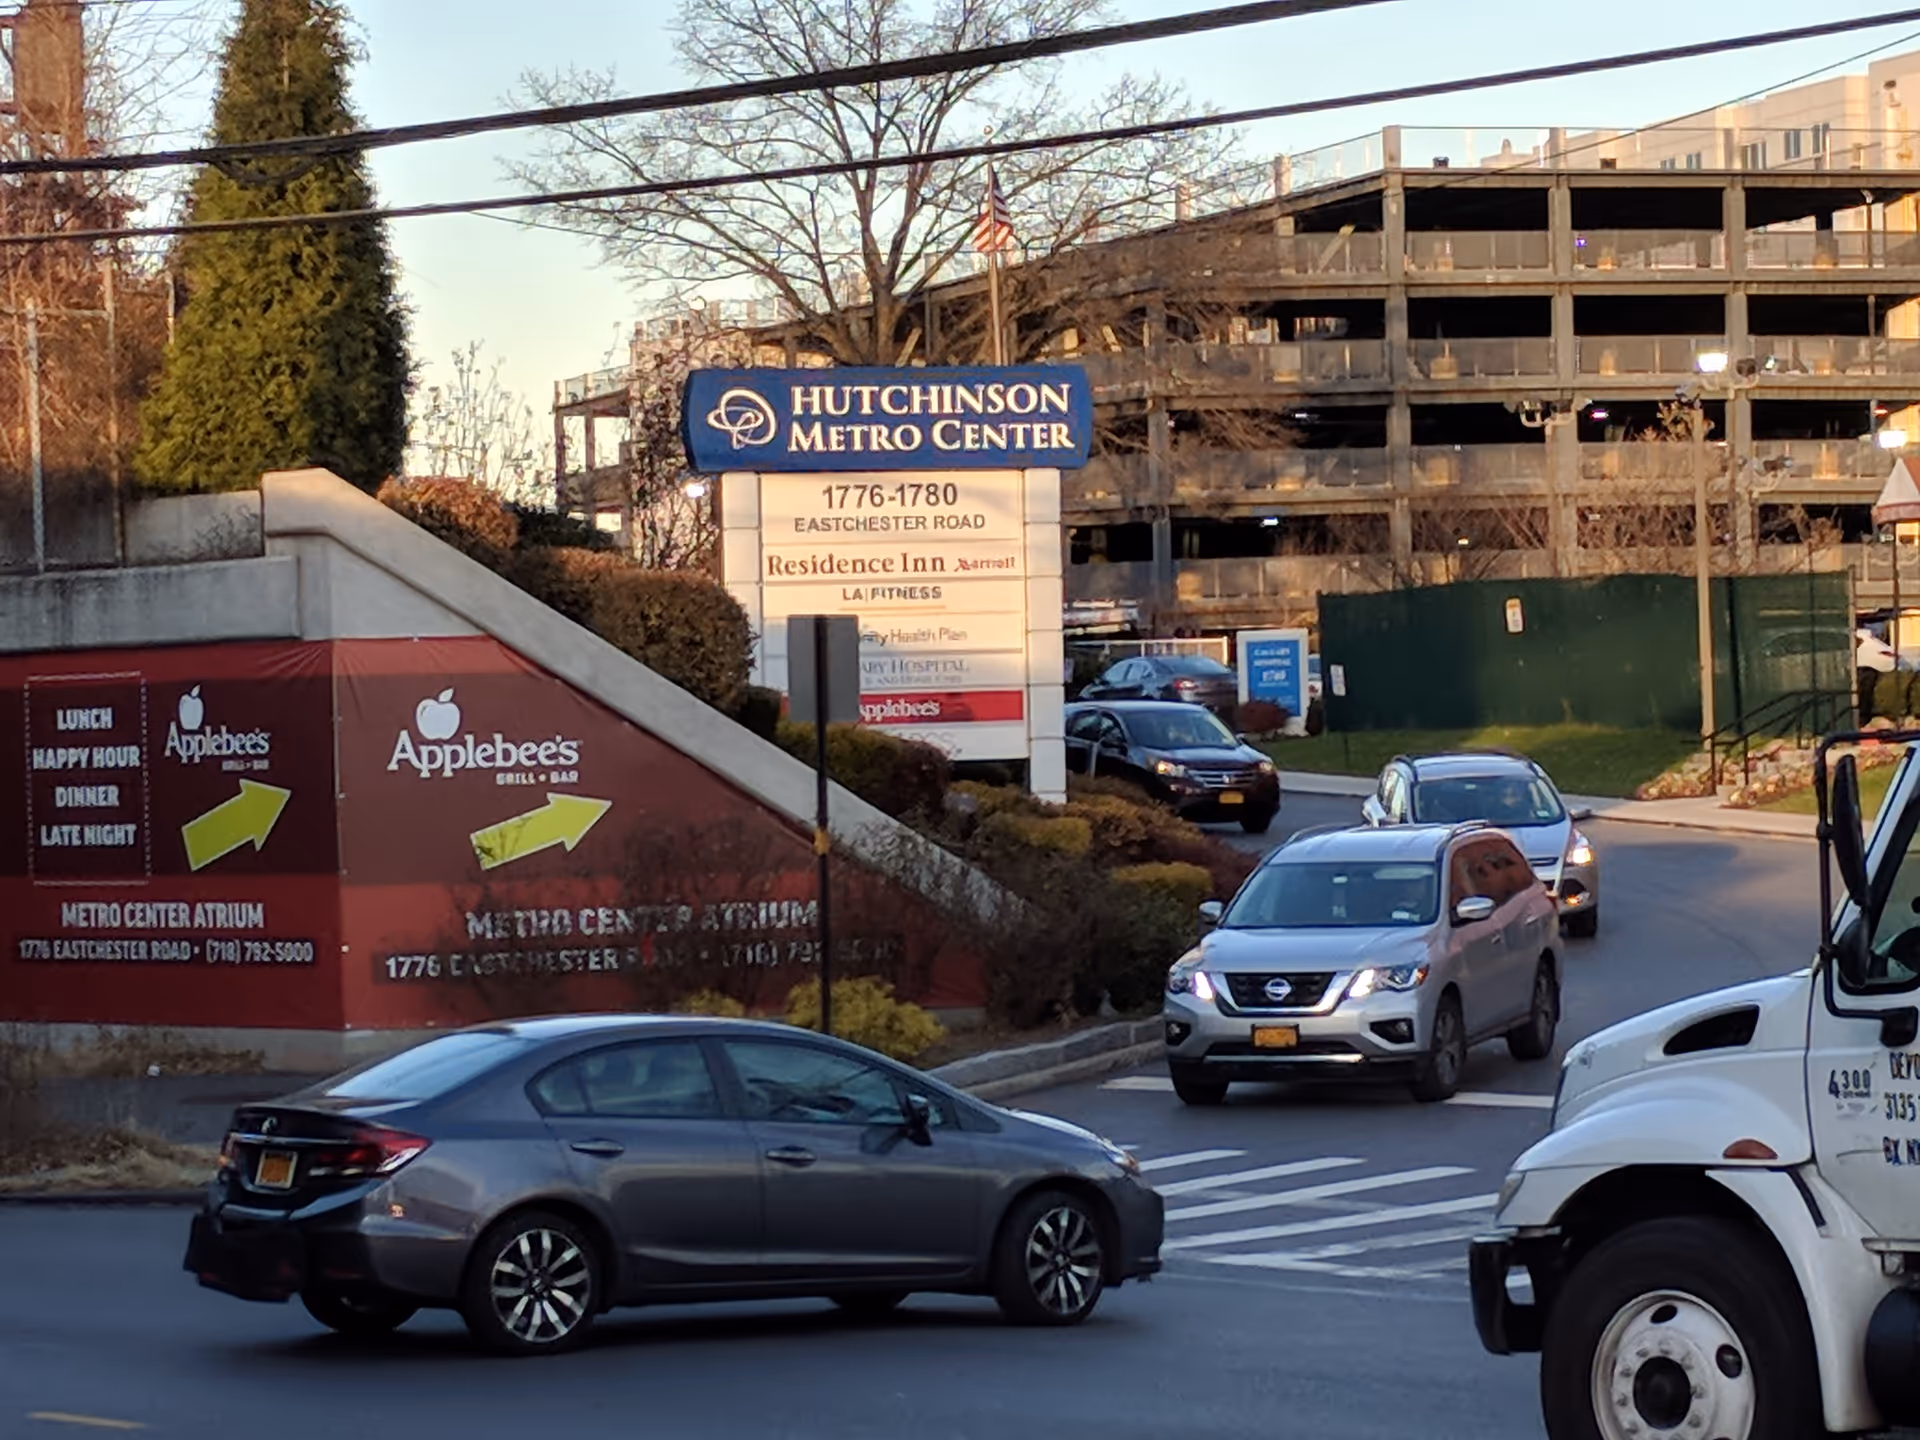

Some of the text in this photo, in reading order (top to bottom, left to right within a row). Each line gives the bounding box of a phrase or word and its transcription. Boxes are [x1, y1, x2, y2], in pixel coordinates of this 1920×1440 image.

[791, 383, 1073, 416] HUTCHINSON
[788, 419, 1075, 452] METRO CENTER
[822, 483, 958, 509] 1776-1780
[795, 514, 985, 533] EASTCHESTER ROAD
[767, 553, 894, 576] Residence
[901, 553, 946, 573] Inn
[57, 707, 113, 730] LUNCH
[164, 721, 270, 763] Applebee's
[387, 729, 582, 778] Applebee's
[33, 745, 140, 769] HAPPY HOUR
[496, 771, 579, 785] GRILL BAR
[55, 785, 119, 807] DINNER
[40, 823, 137, 846] LATE NIGHT
[62, 902, 264, 928] METRO CENTER ATRIUM
[465, 908, 572, 939] METRO
[53, 940, 148, 960] EASTCHESTER
[151, 940, 191, 960] ROAD
[385, 955, 441, 978] 1776
[1828, 1069, 1871, 1098] 4300
